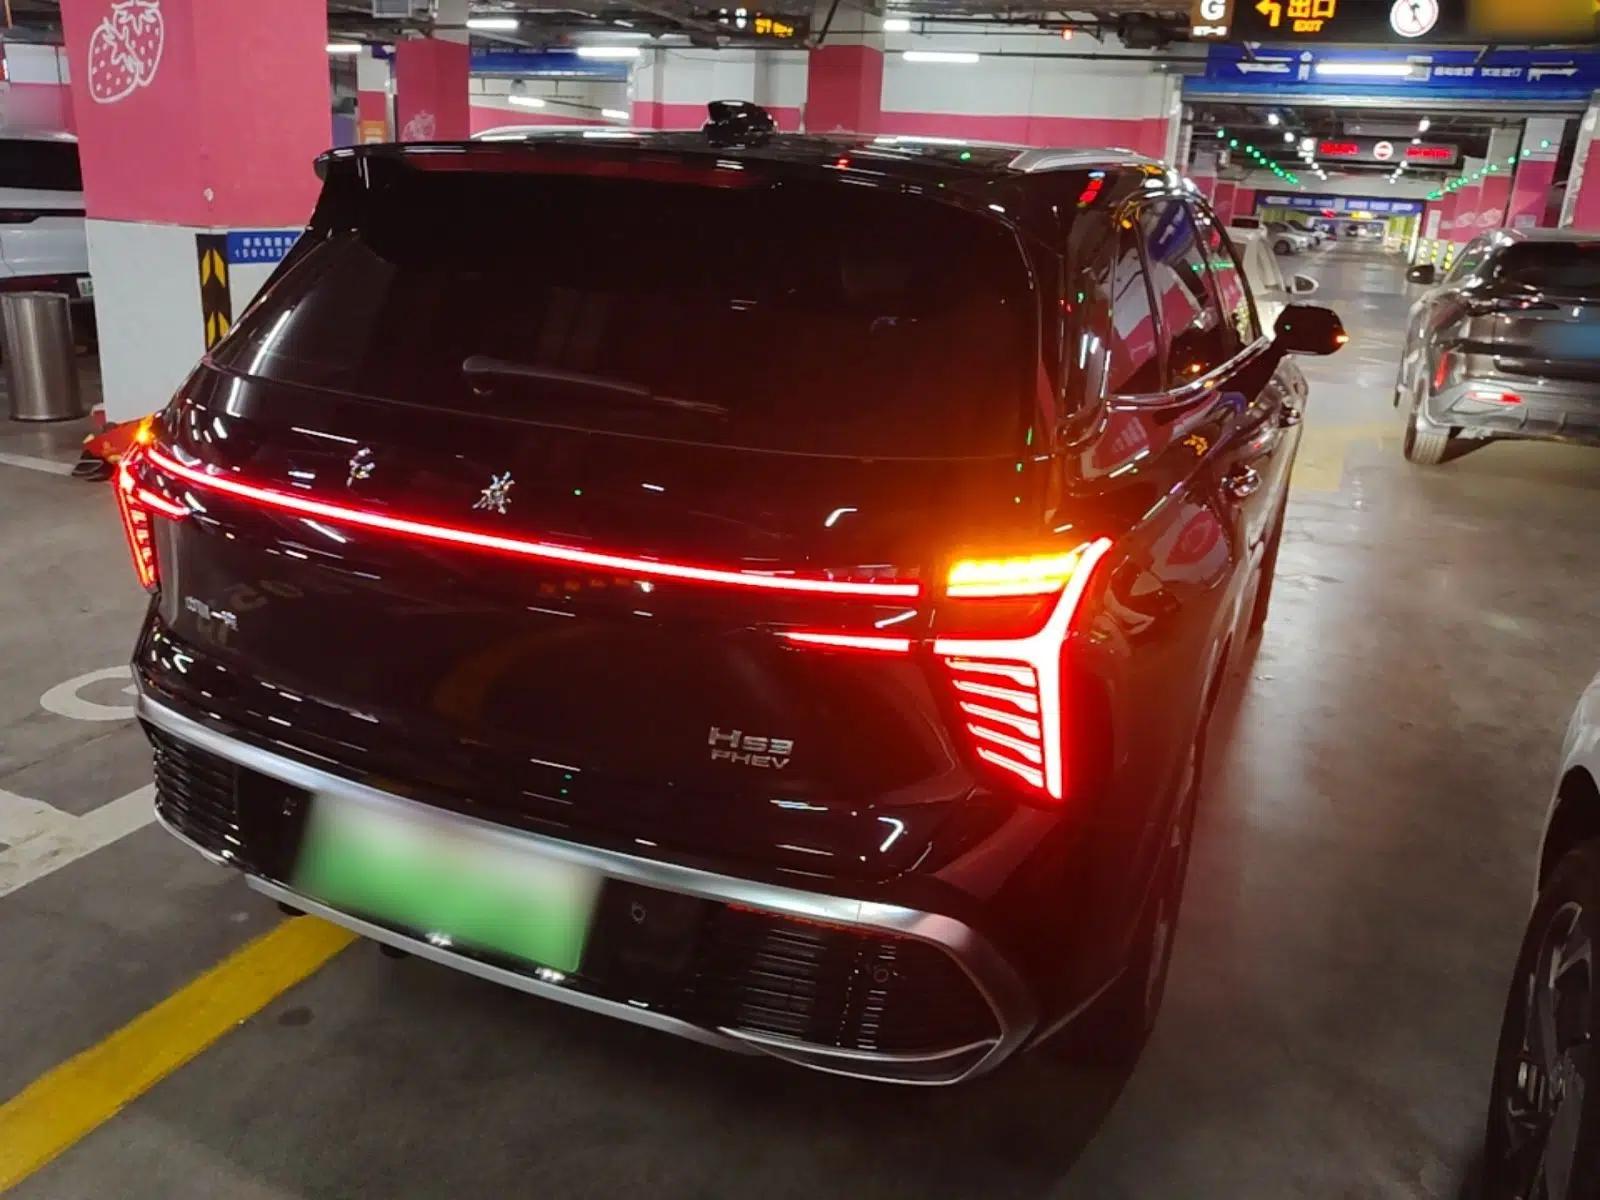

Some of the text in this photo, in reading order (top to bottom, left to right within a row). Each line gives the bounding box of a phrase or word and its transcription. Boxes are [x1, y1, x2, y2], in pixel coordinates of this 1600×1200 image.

[1200, 0, 1226, 21] G
[1287, 0, 1336, 18] 出口
[708, 726, 794, 755] HS3
[711, 749, 790, 769] PHEV
